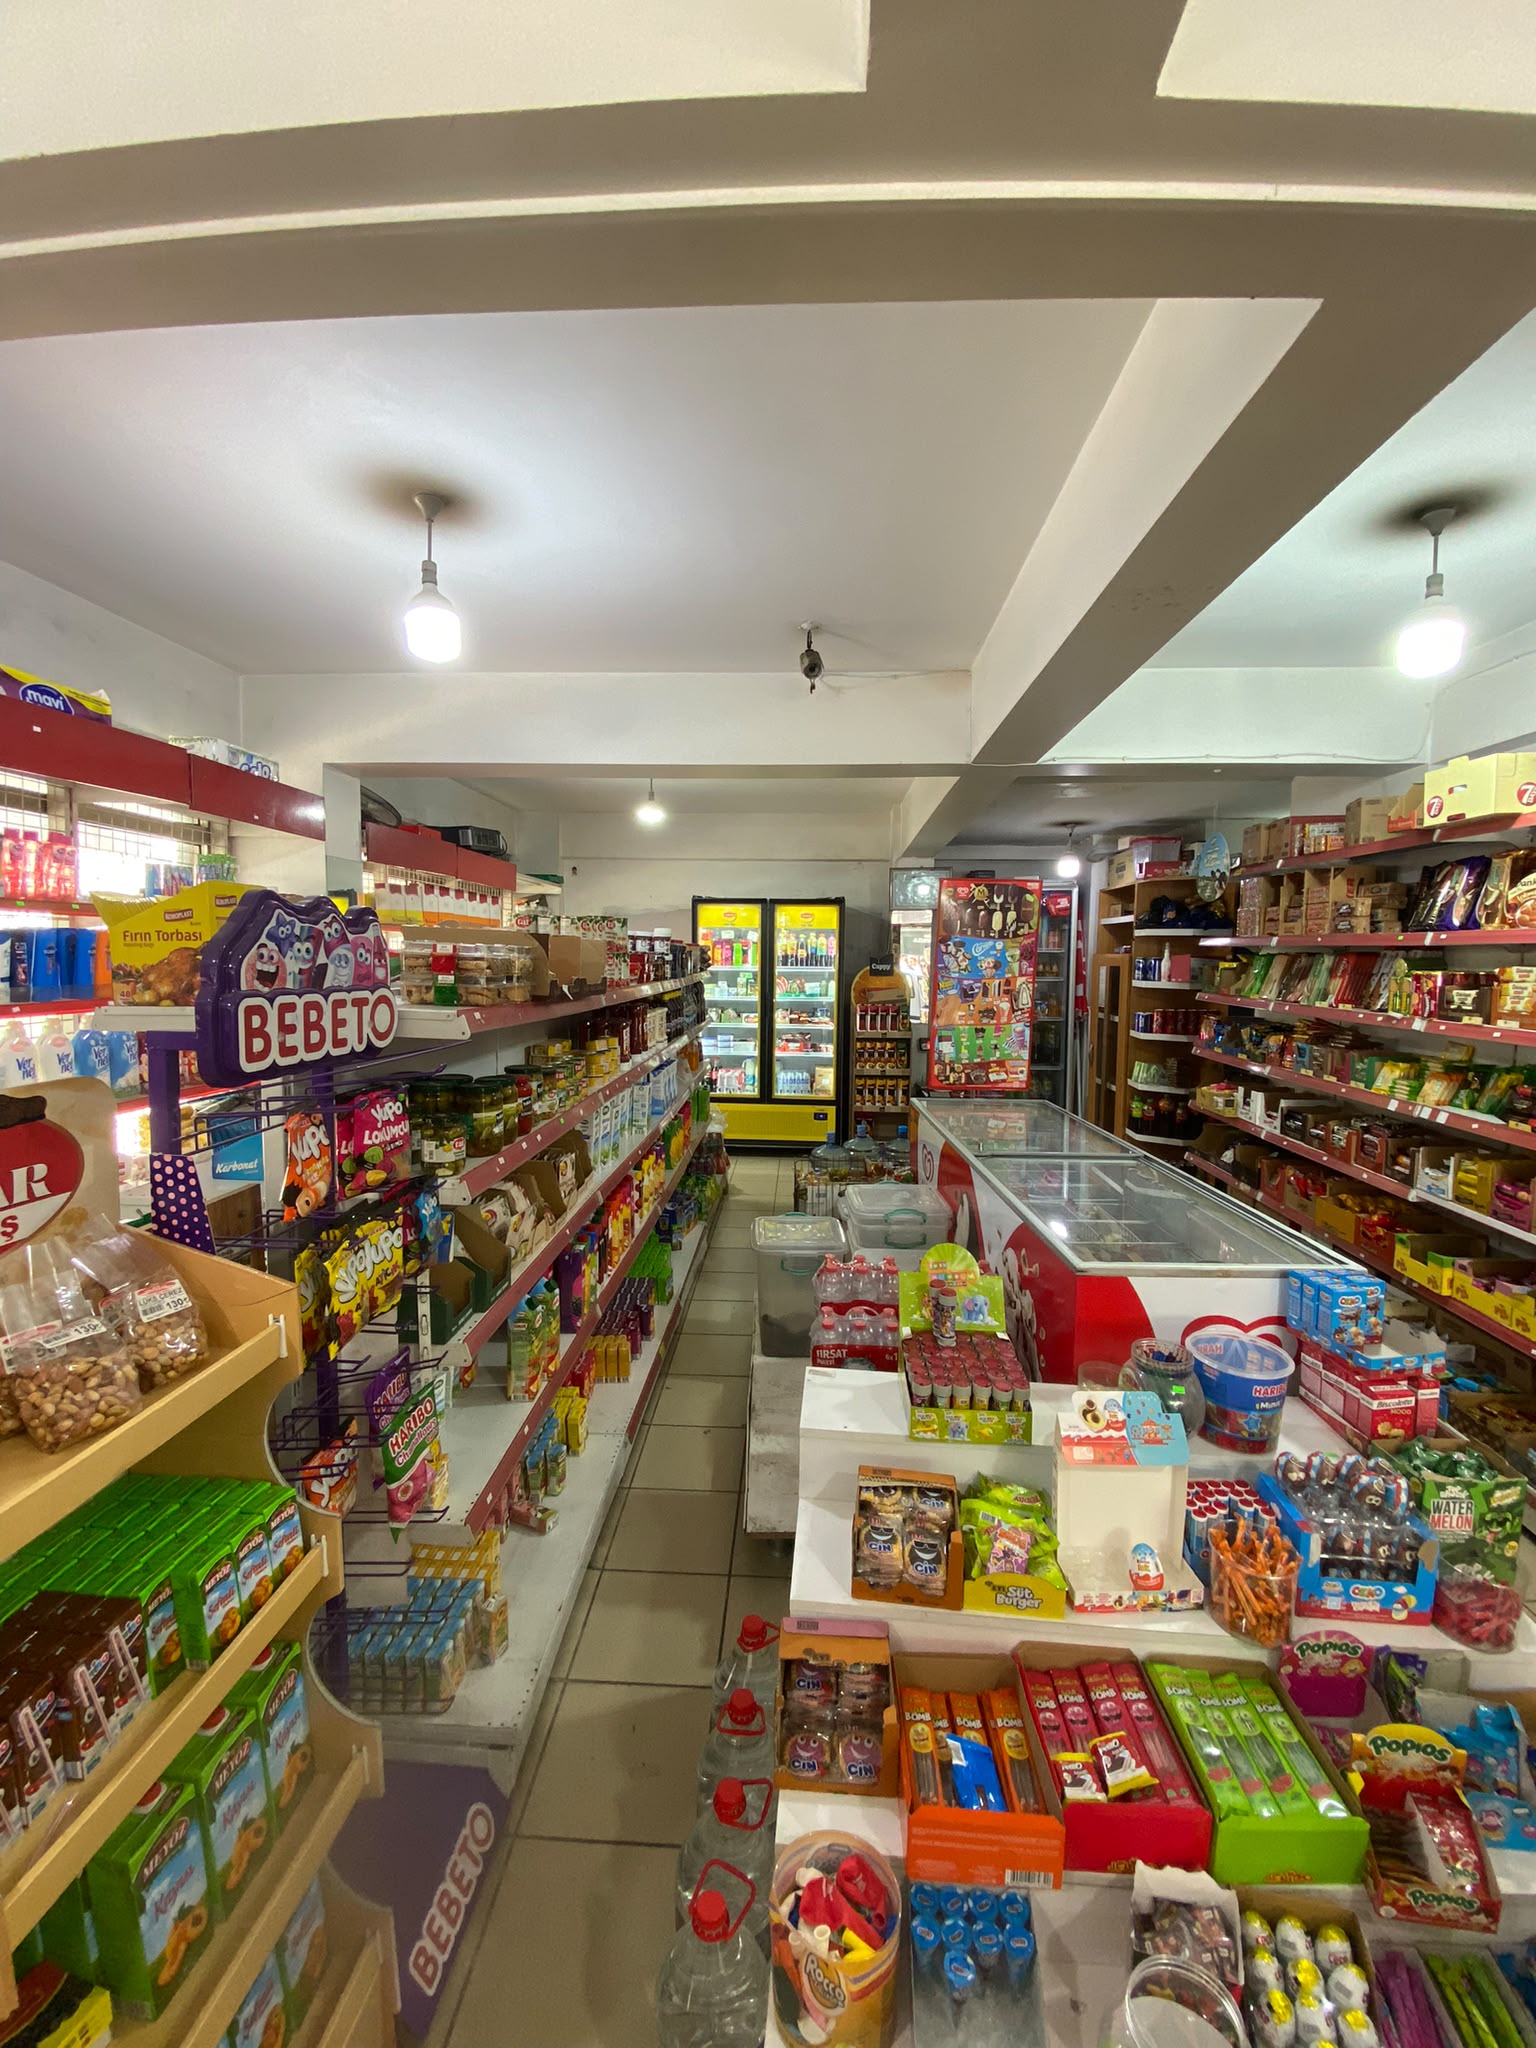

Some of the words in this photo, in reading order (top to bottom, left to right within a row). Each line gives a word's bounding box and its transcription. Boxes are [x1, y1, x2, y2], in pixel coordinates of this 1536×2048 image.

[27, 689, 65, 711] mavi
[123, 930, 151, 942] Fırın
[155, 929, 202, 942] Torbası
[871, 963, 891, 971] Cappy
[243, 993, 396, 1064] BEBETO
[216, 1158, 258, 1174] Karbonat
[389, 1397, 434, 1458] HARIBO
[1432, 1500, 1473, 1515] WATER
[1430, 1514, 1473, 1529] MELON
[996, 1593, 1042, 1610] Burger
[905, 1711, 931, 1721] BOMB
[956, 1716, 982, 1729] BOMB
[996, 1717, 1023, 1728] BOMB
[411, 1806, 494, 1992] BEBETO
